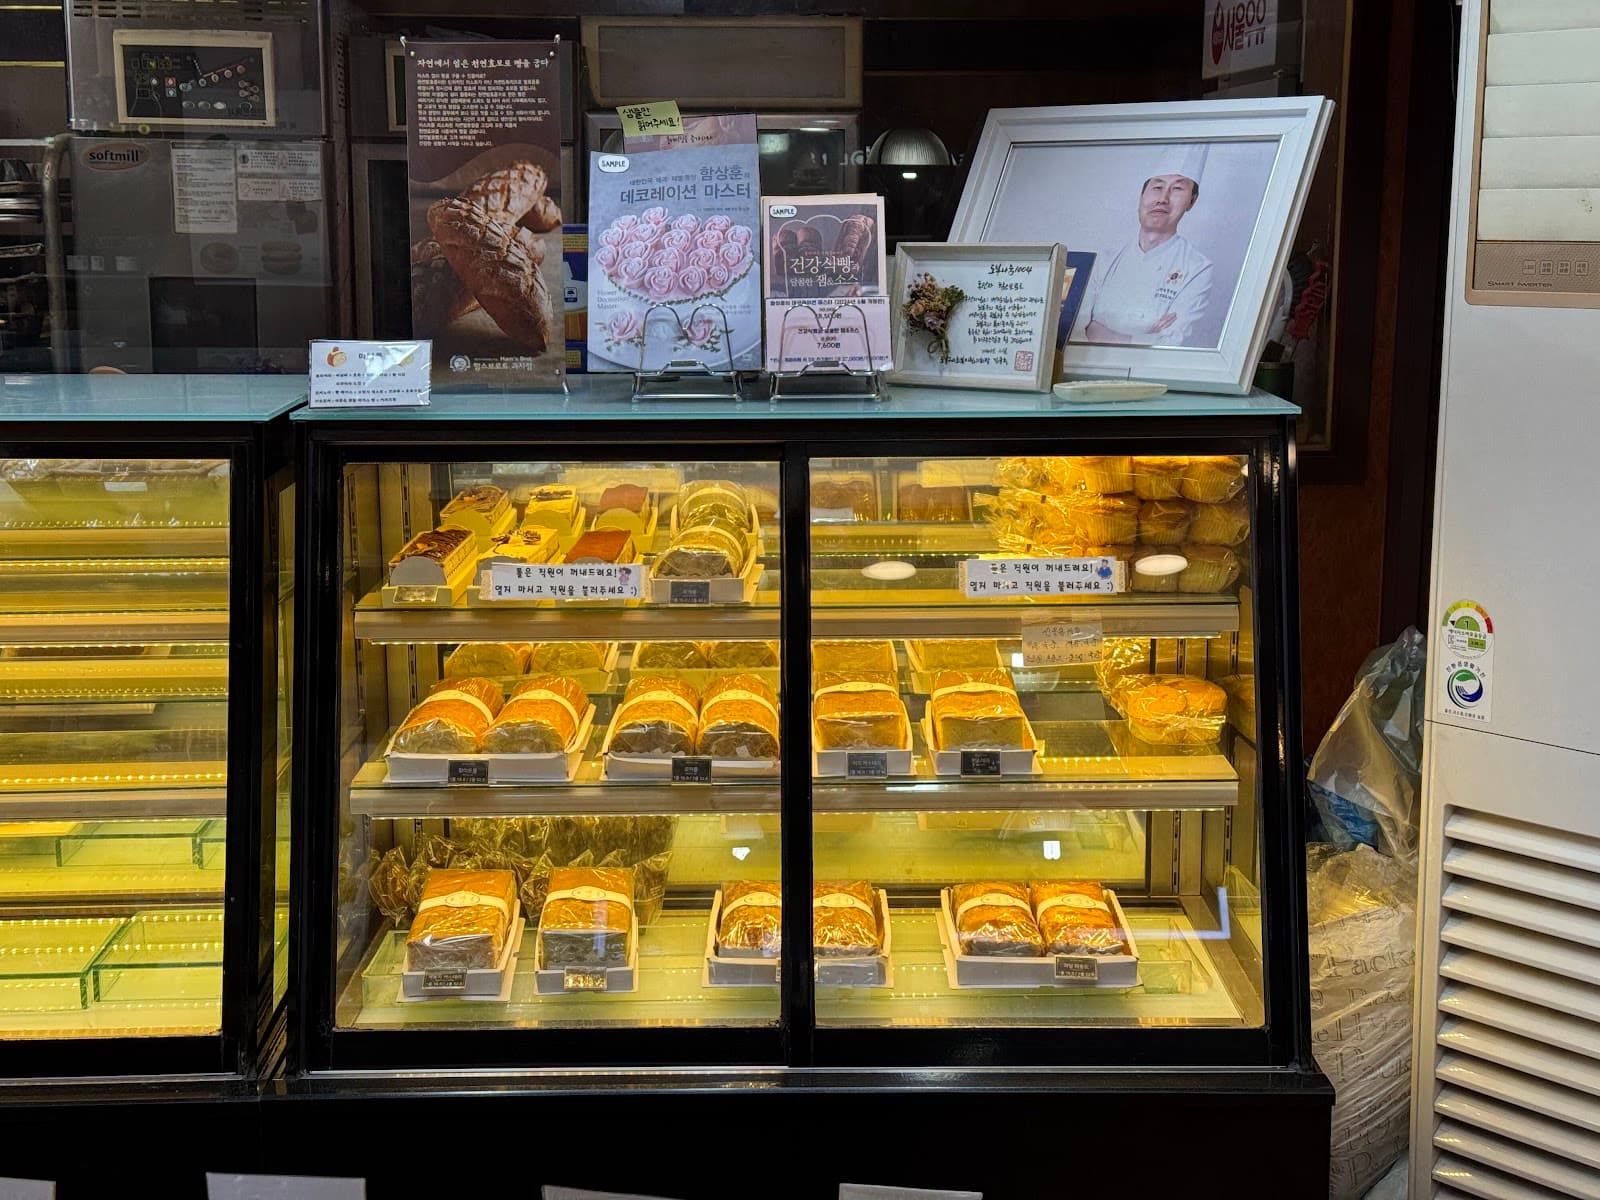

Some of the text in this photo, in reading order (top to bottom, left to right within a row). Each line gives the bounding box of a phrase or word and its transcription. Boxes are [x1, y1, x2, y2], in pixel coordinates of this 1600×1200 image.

[416, 58, 450, 69] 자연에서
[622, 106, 652, 120] 샘플만
[637, 117, 681, 132] 읽어주세요!
[89, 149, 140, 162] softmill
[601, 159, 626, 168] SAMPLE
[620, 182, 751, 204] 데코레이션 마스터
[772, 207, 796, 215] SAMPLE
[815, 273, 859, 287] 잼&소스
[538, 567, 564, 578] 직원이
[570, 567, 617, 578] 꺼내드려요!
[1013, 563, 1039, 574] 직원이
[1045, 562, 1093, 573] 꺼내드려요!
[494, 585, 511, 596] 열지
[518, 585, 543, 594] 마시고
[549, 585, 575, 597] 직원을
[581, 585, 625, 597] 불러주세요
[970, 581, 986, 592] 열지
[1024, 581, 1051, 592] 직원을
[1058, 581, 1101, 592] 불러주세요
